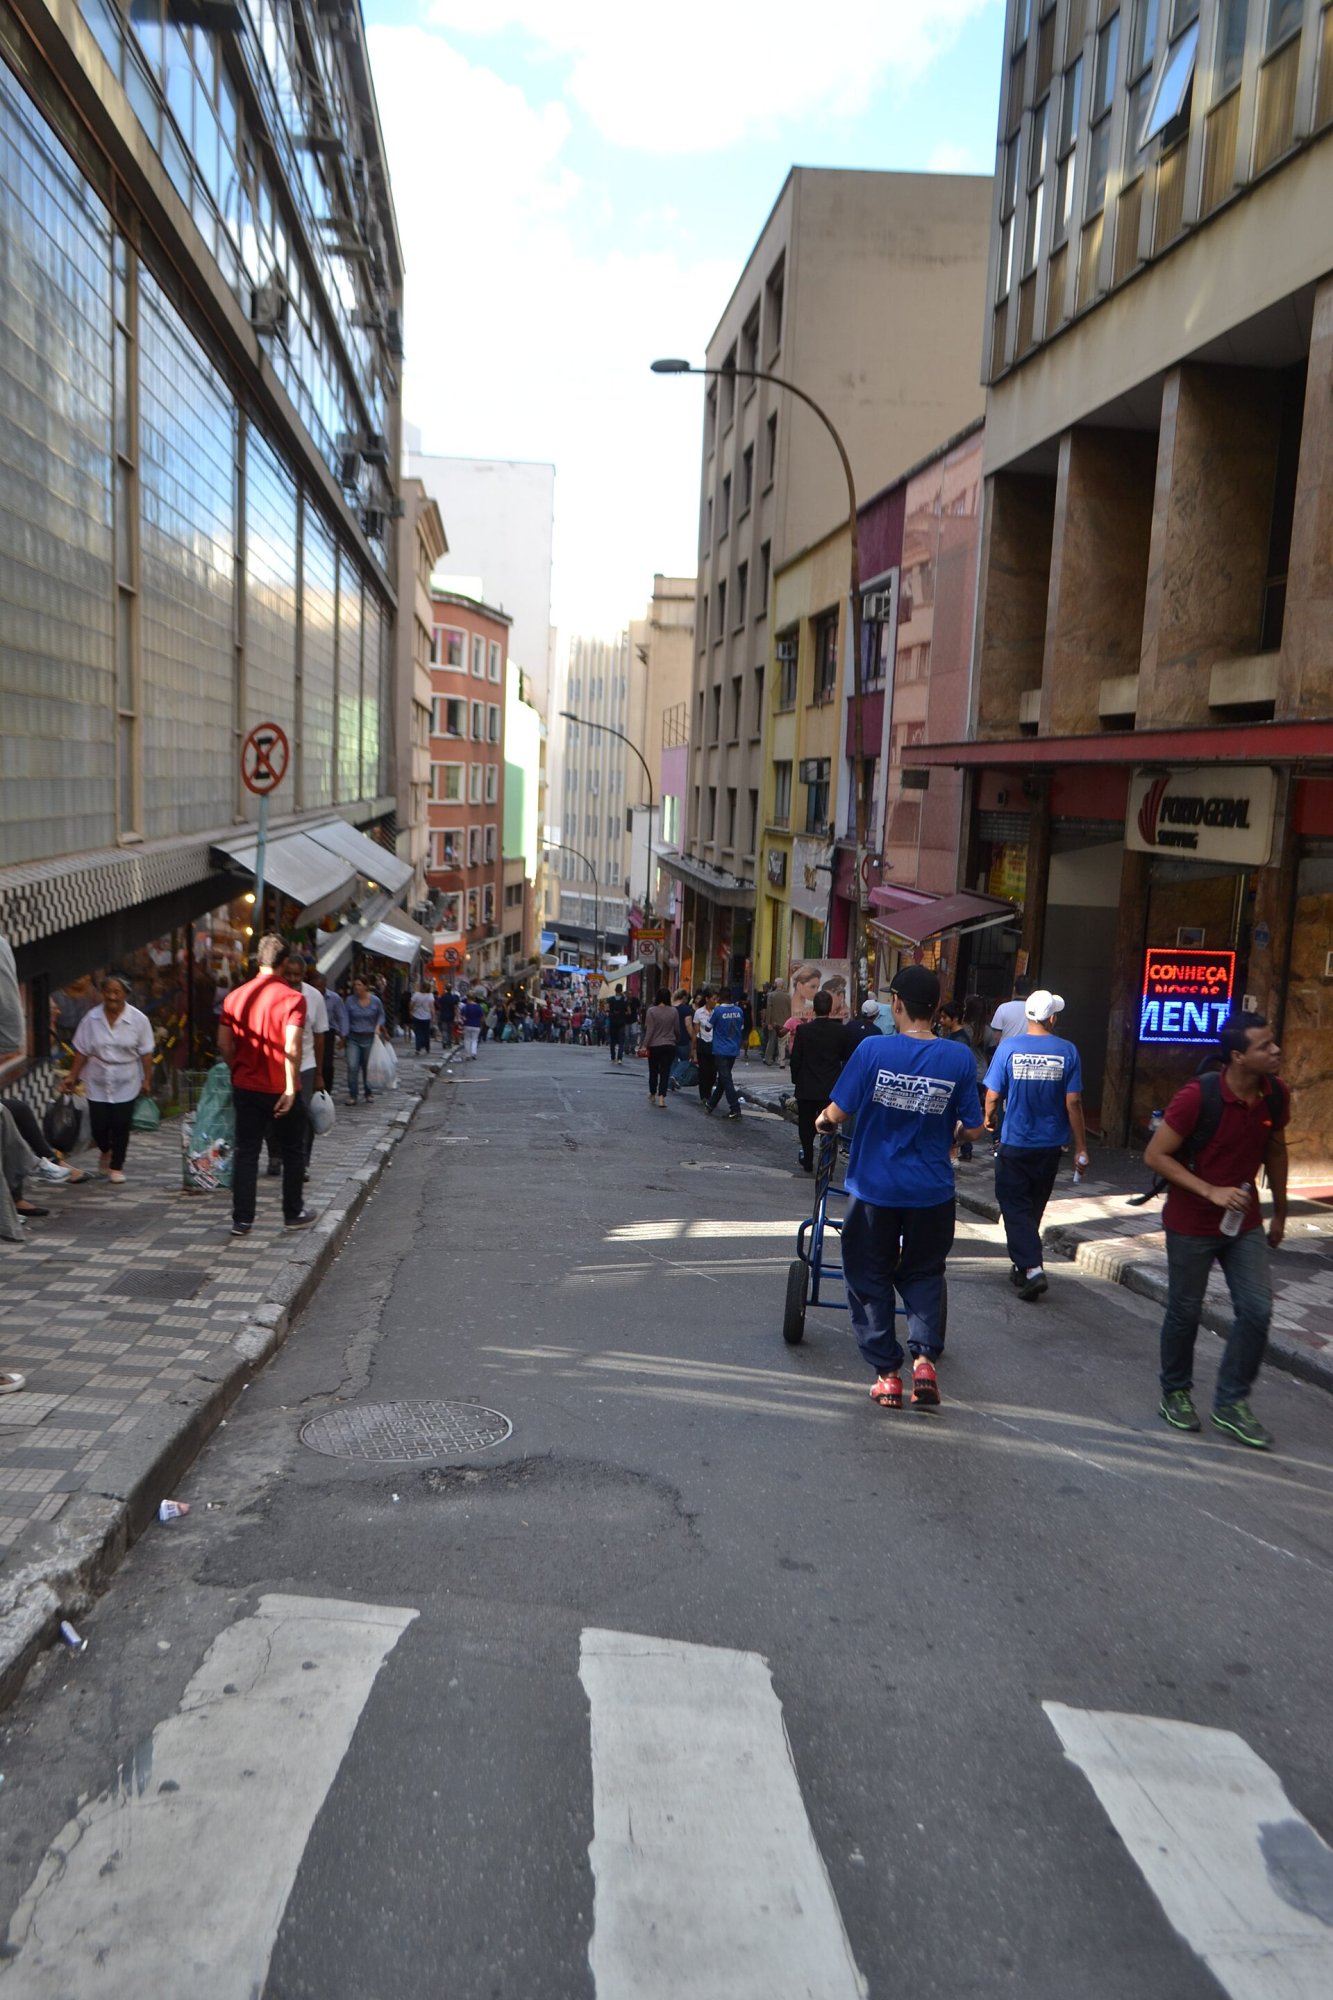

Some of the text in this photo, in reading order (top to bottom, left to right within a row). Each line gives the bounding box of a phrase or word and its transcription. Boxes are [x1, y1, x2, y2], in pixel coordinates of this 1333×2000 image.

[1149, 964, 1228, 985] CONHEÇA
[1014, 1054, 1047, 1066] DATA
[878, 1070, 929, 1094] DATA
